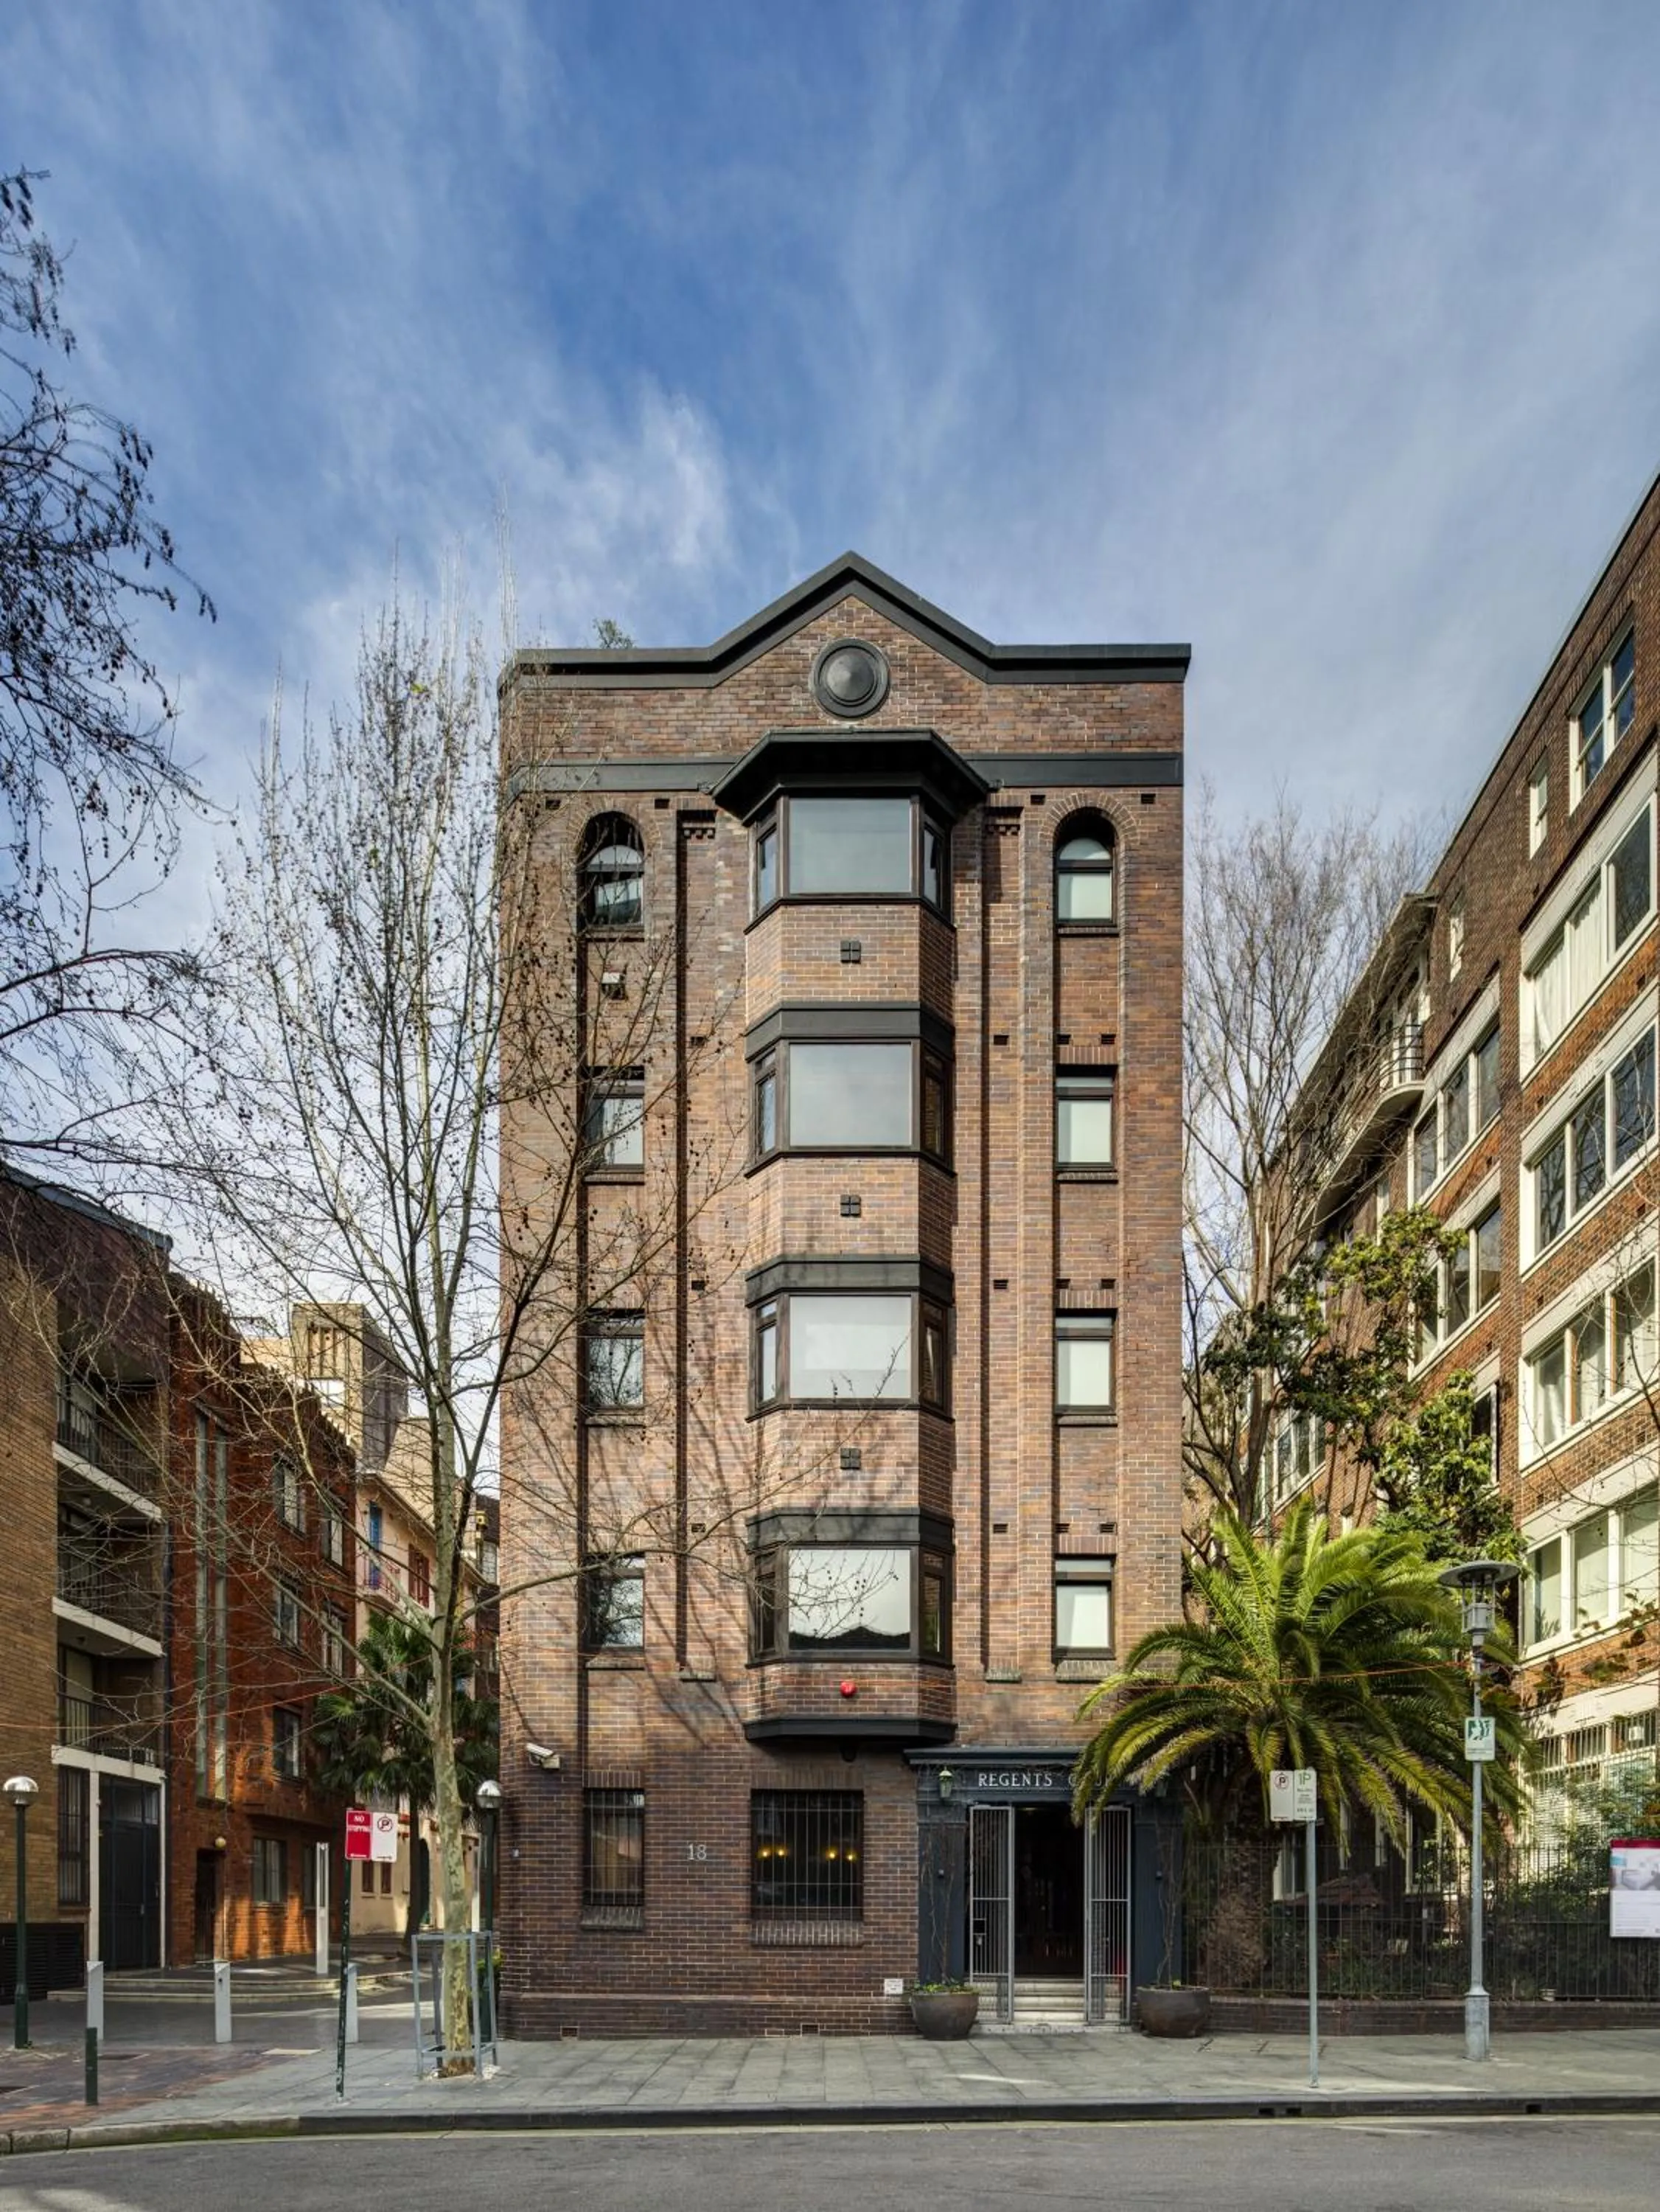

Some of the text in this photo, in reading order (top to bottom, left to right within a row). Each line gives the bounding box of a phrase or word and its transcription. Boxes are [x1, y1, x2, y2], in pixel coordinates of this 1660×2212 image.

[978, 1773, 1053, 1787] REGENTS
[1299, 1773, 1311, 1785] 1P
[688, 1843, 707, 1860] 18
